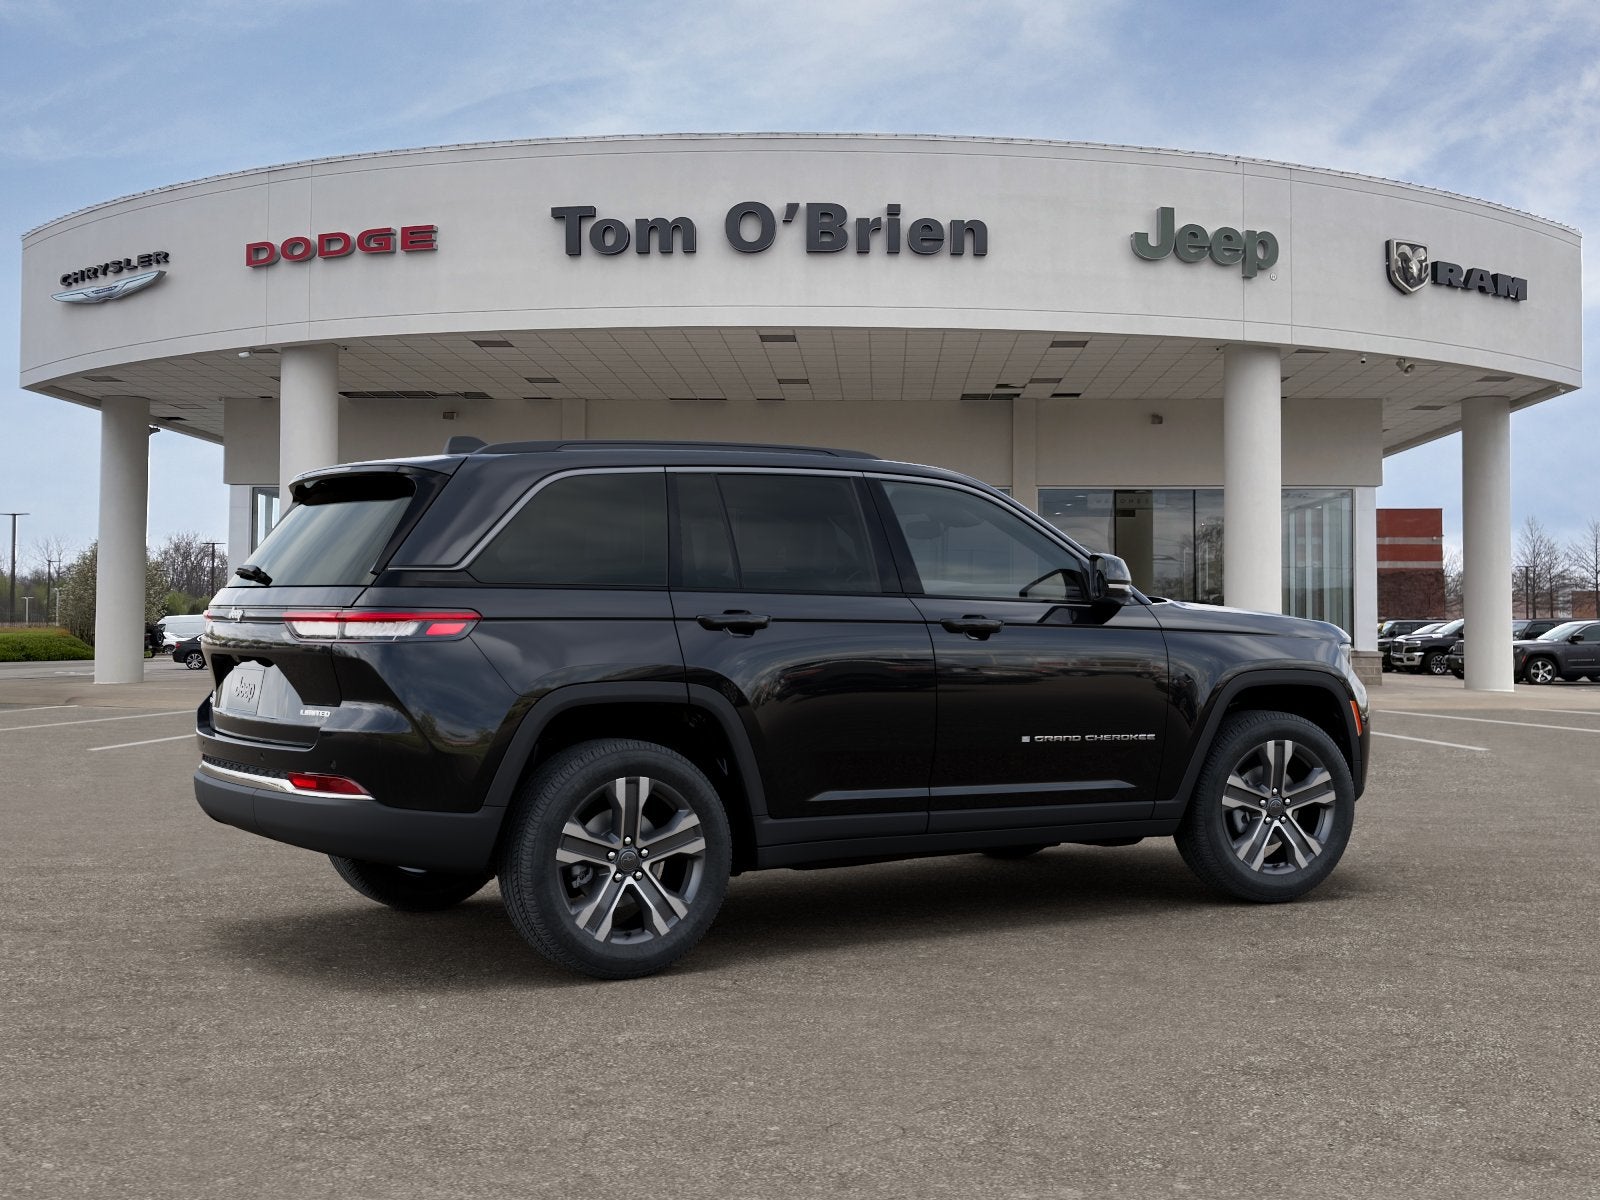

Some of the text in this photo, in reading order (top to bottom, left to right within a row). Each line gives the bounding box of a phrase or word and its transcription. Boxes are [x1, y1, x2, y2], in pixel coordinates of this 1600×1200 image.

[245, 224, 438, 268] DODGE
[551, 201, 989, 256] Tom O'Brien
[1131, 206, 1279, 279] Jeep
[60, 251, 169, 287] CHRYSLER
[1431, 260, 1528, 303] RAM
[300, 709, 331, 718] LIMITED
